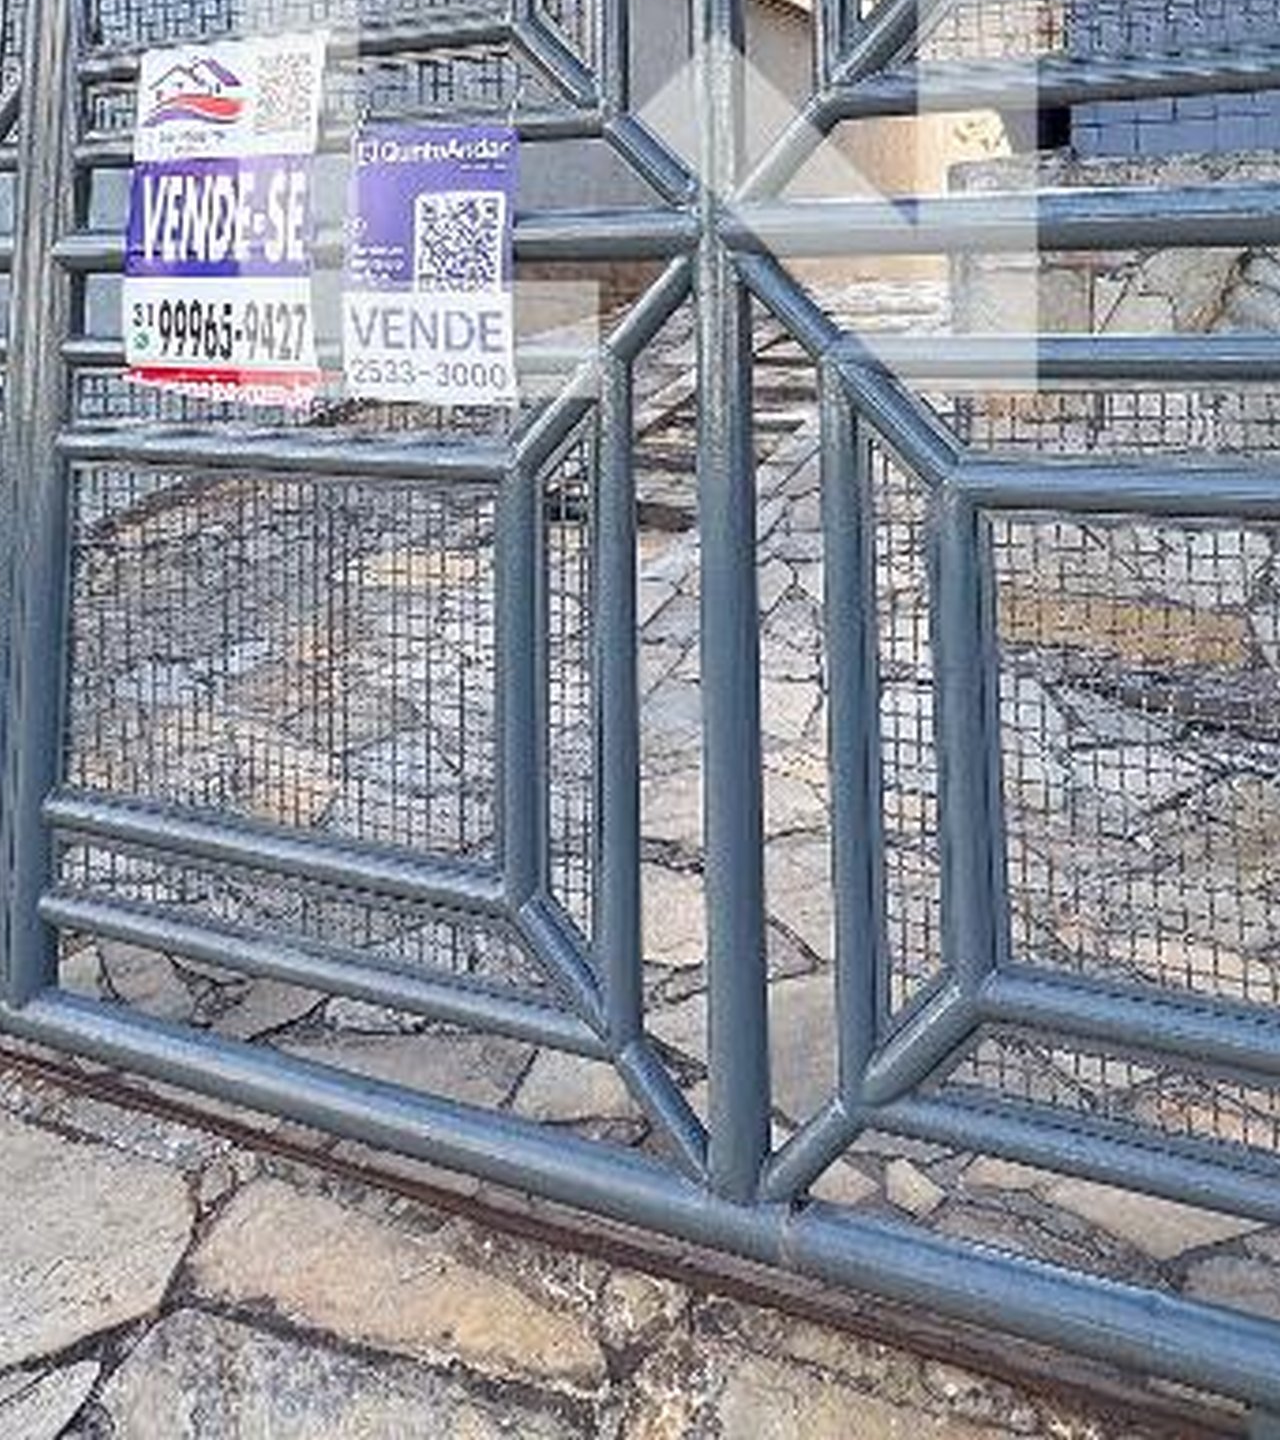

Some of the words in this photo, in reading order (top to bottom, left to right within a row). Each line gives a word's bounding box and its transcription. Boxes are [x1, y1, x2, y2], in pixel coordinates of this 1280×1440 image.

[142, 171, 306, 261] VENDE-SE
[157, 299, 308, 361] 99965-9427
[350, 310, 504, 353] VENDE
[352, 361, 505, 389] 2533-3000
